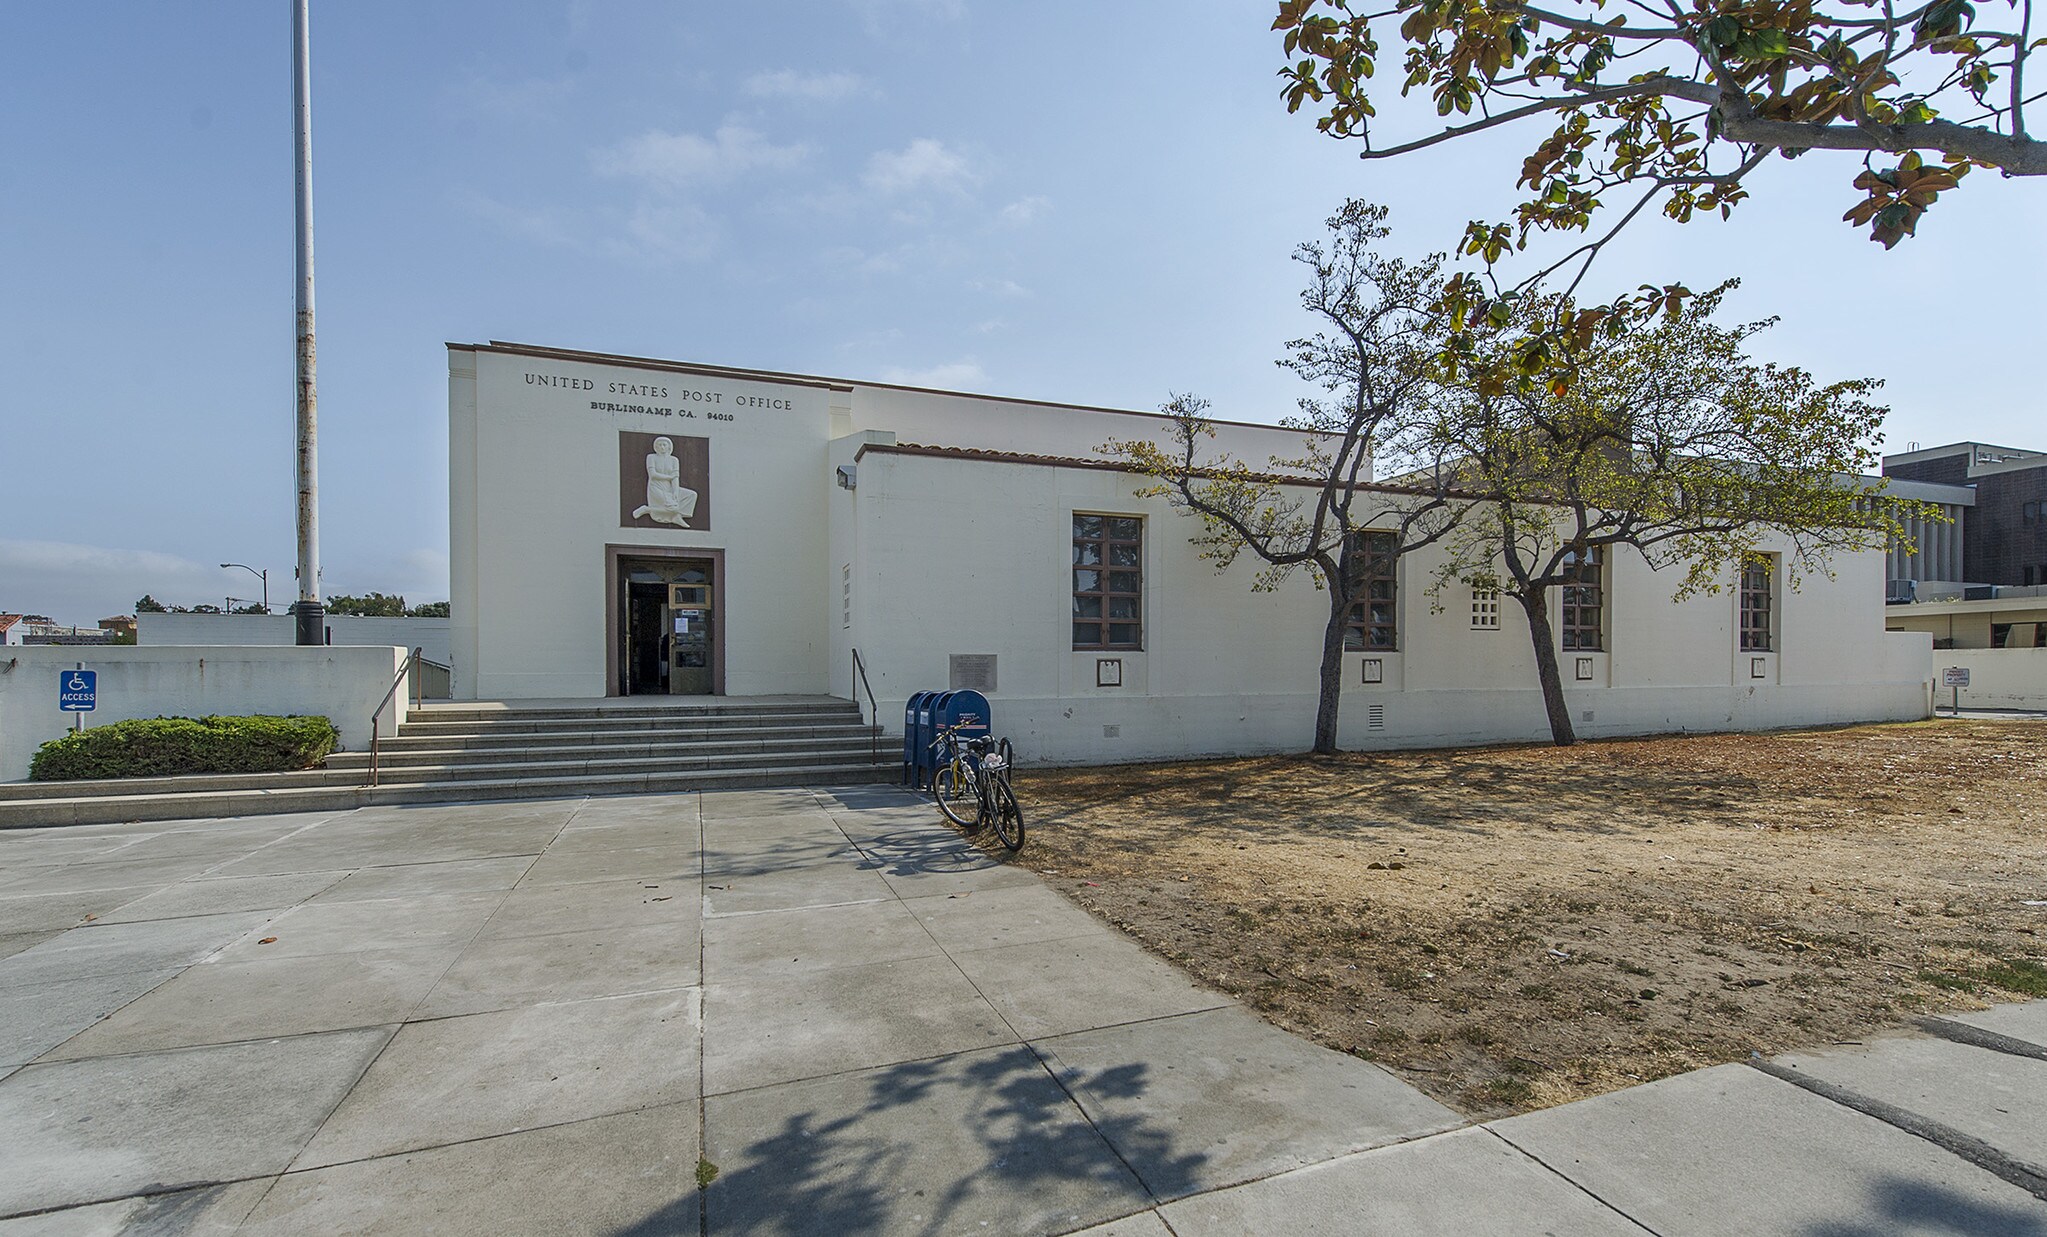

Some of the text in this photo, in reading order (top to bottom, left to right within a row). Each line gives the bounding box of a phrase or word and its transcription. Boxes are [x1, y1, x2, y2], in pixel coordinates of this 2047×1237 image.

[525, 373, 792, 411] UNITED STATES POST OFFICE
[590, 401, 734, 421] BURLINGAME CA. 94010
[61, 693, 95, 701] ACCESS
